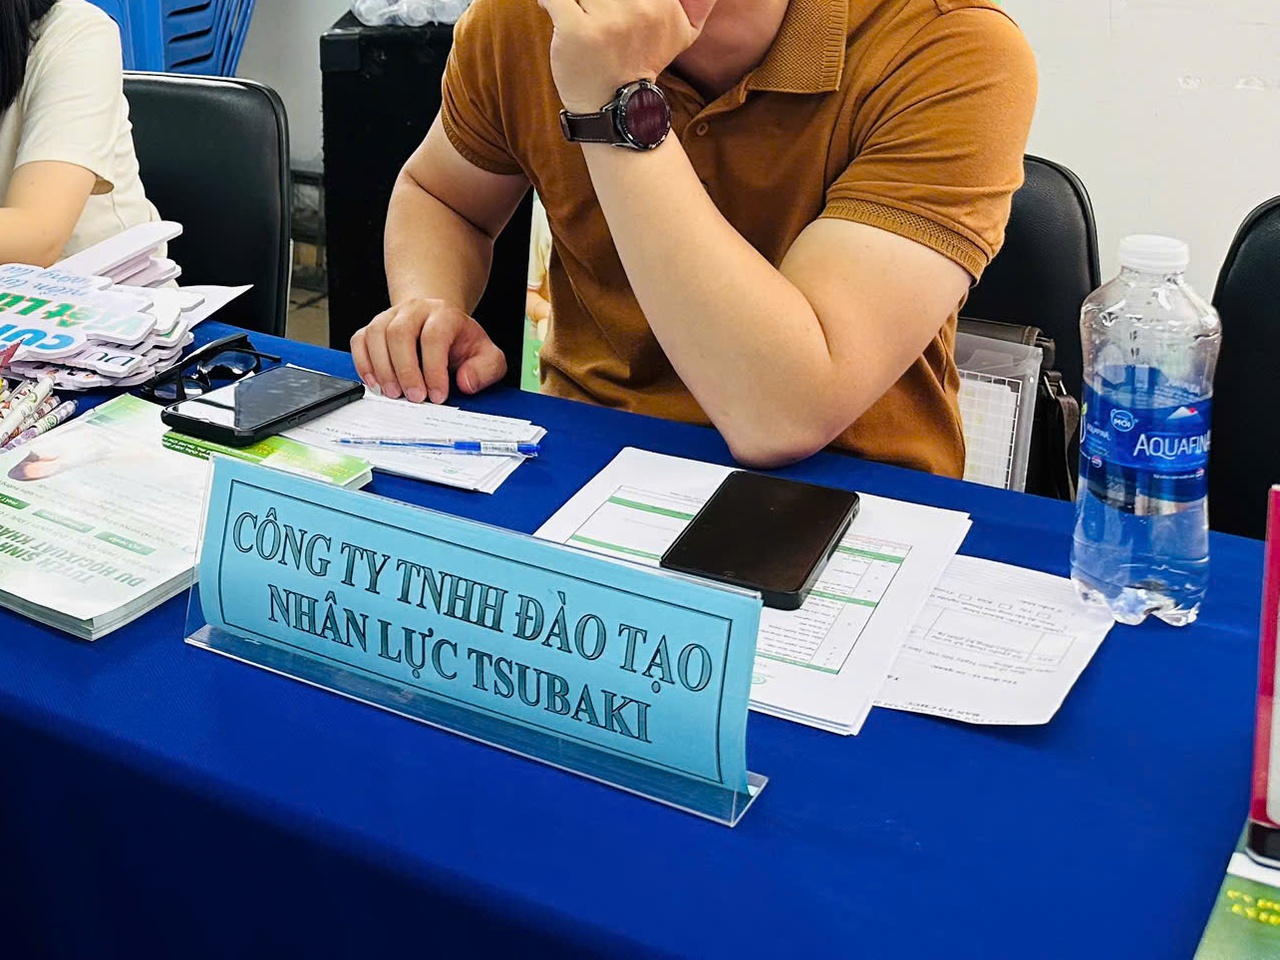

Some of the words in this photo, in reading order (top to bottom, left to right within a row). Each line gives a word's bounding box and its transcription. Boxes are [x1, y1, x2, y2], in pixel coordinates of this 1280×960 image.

[231, 507, 332, 578] CÔNG
[340, 541, 390, 594] TY
[396, 557, 509, 633] TNHH
[514, 592, 607, 661] ĐÀO
[618, 622, 712, 693] TẠO
[268, 583, 370, 653] NHÂN
[377, 620, 458, 680] LỰC
[467, 647, 653, 744] TSUBAKI
